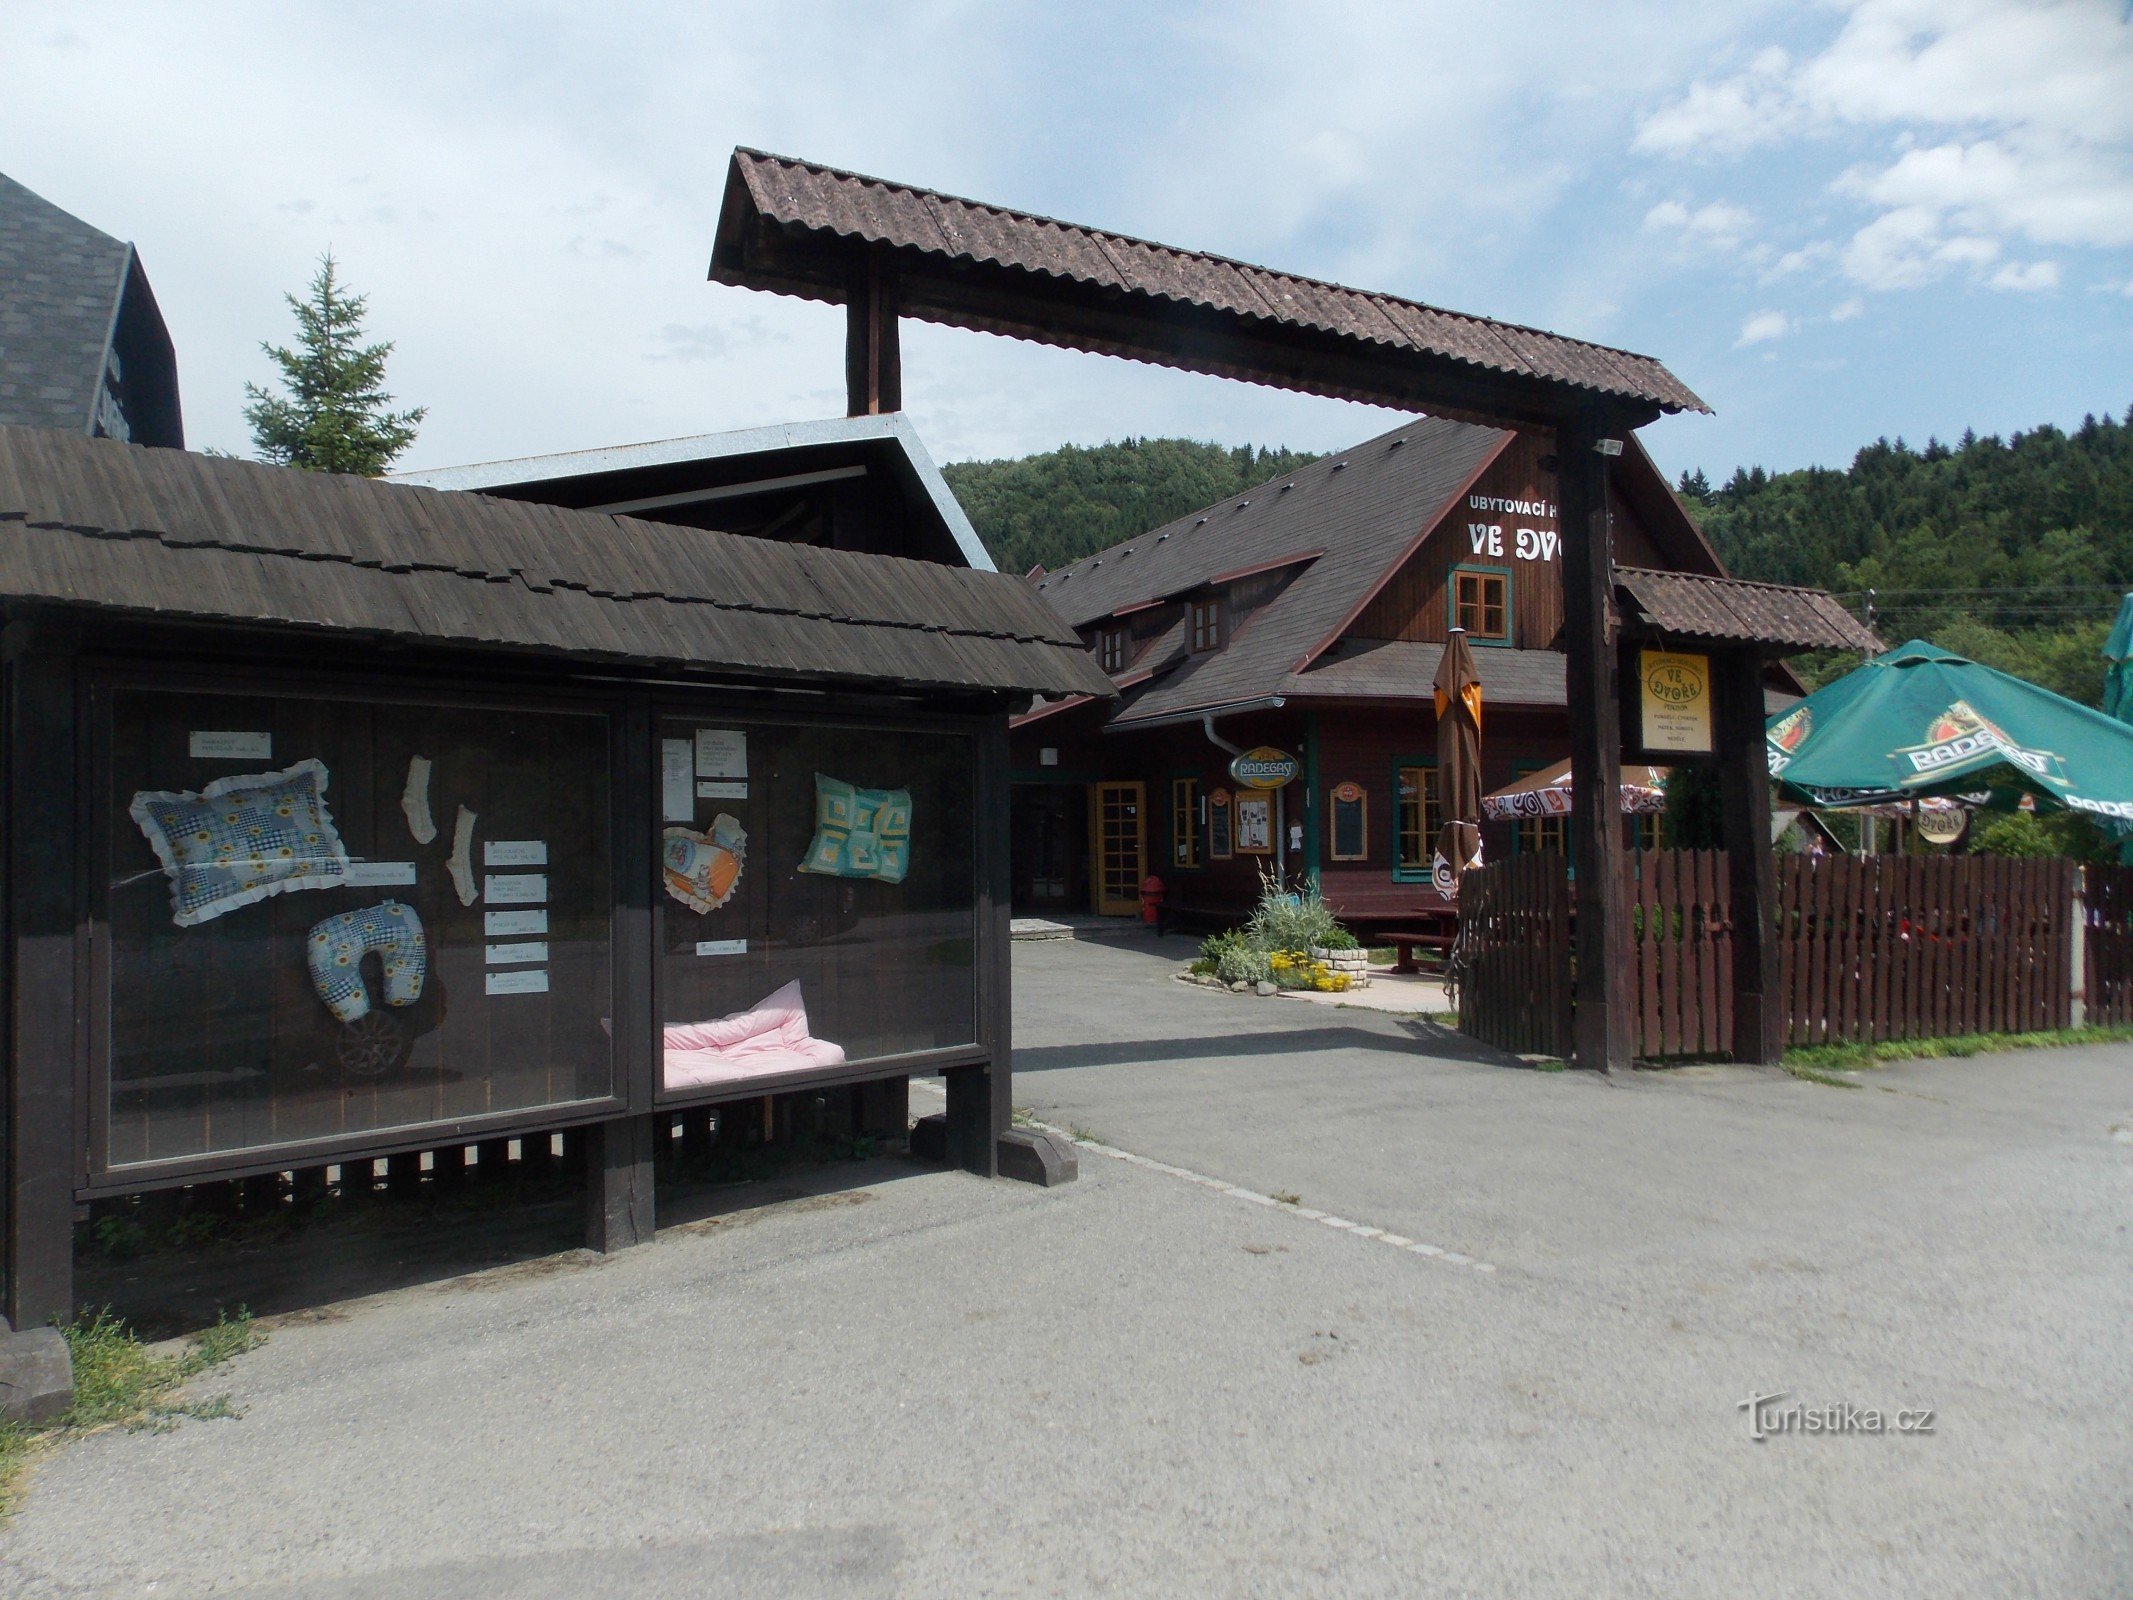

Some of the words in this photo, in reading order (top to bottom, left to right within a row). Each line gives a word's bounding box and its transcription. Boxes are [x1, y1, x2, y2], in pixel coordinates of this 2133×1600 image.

[1469, 495, 1546, 517] UBYTOVACÍ
[1467, 523, 1504, 558] VE
[1515, 528, 1562, 562] DV
[1667, 668, 1682, 683] VE
[1240, 762, 1294, 777] RADEGAST
